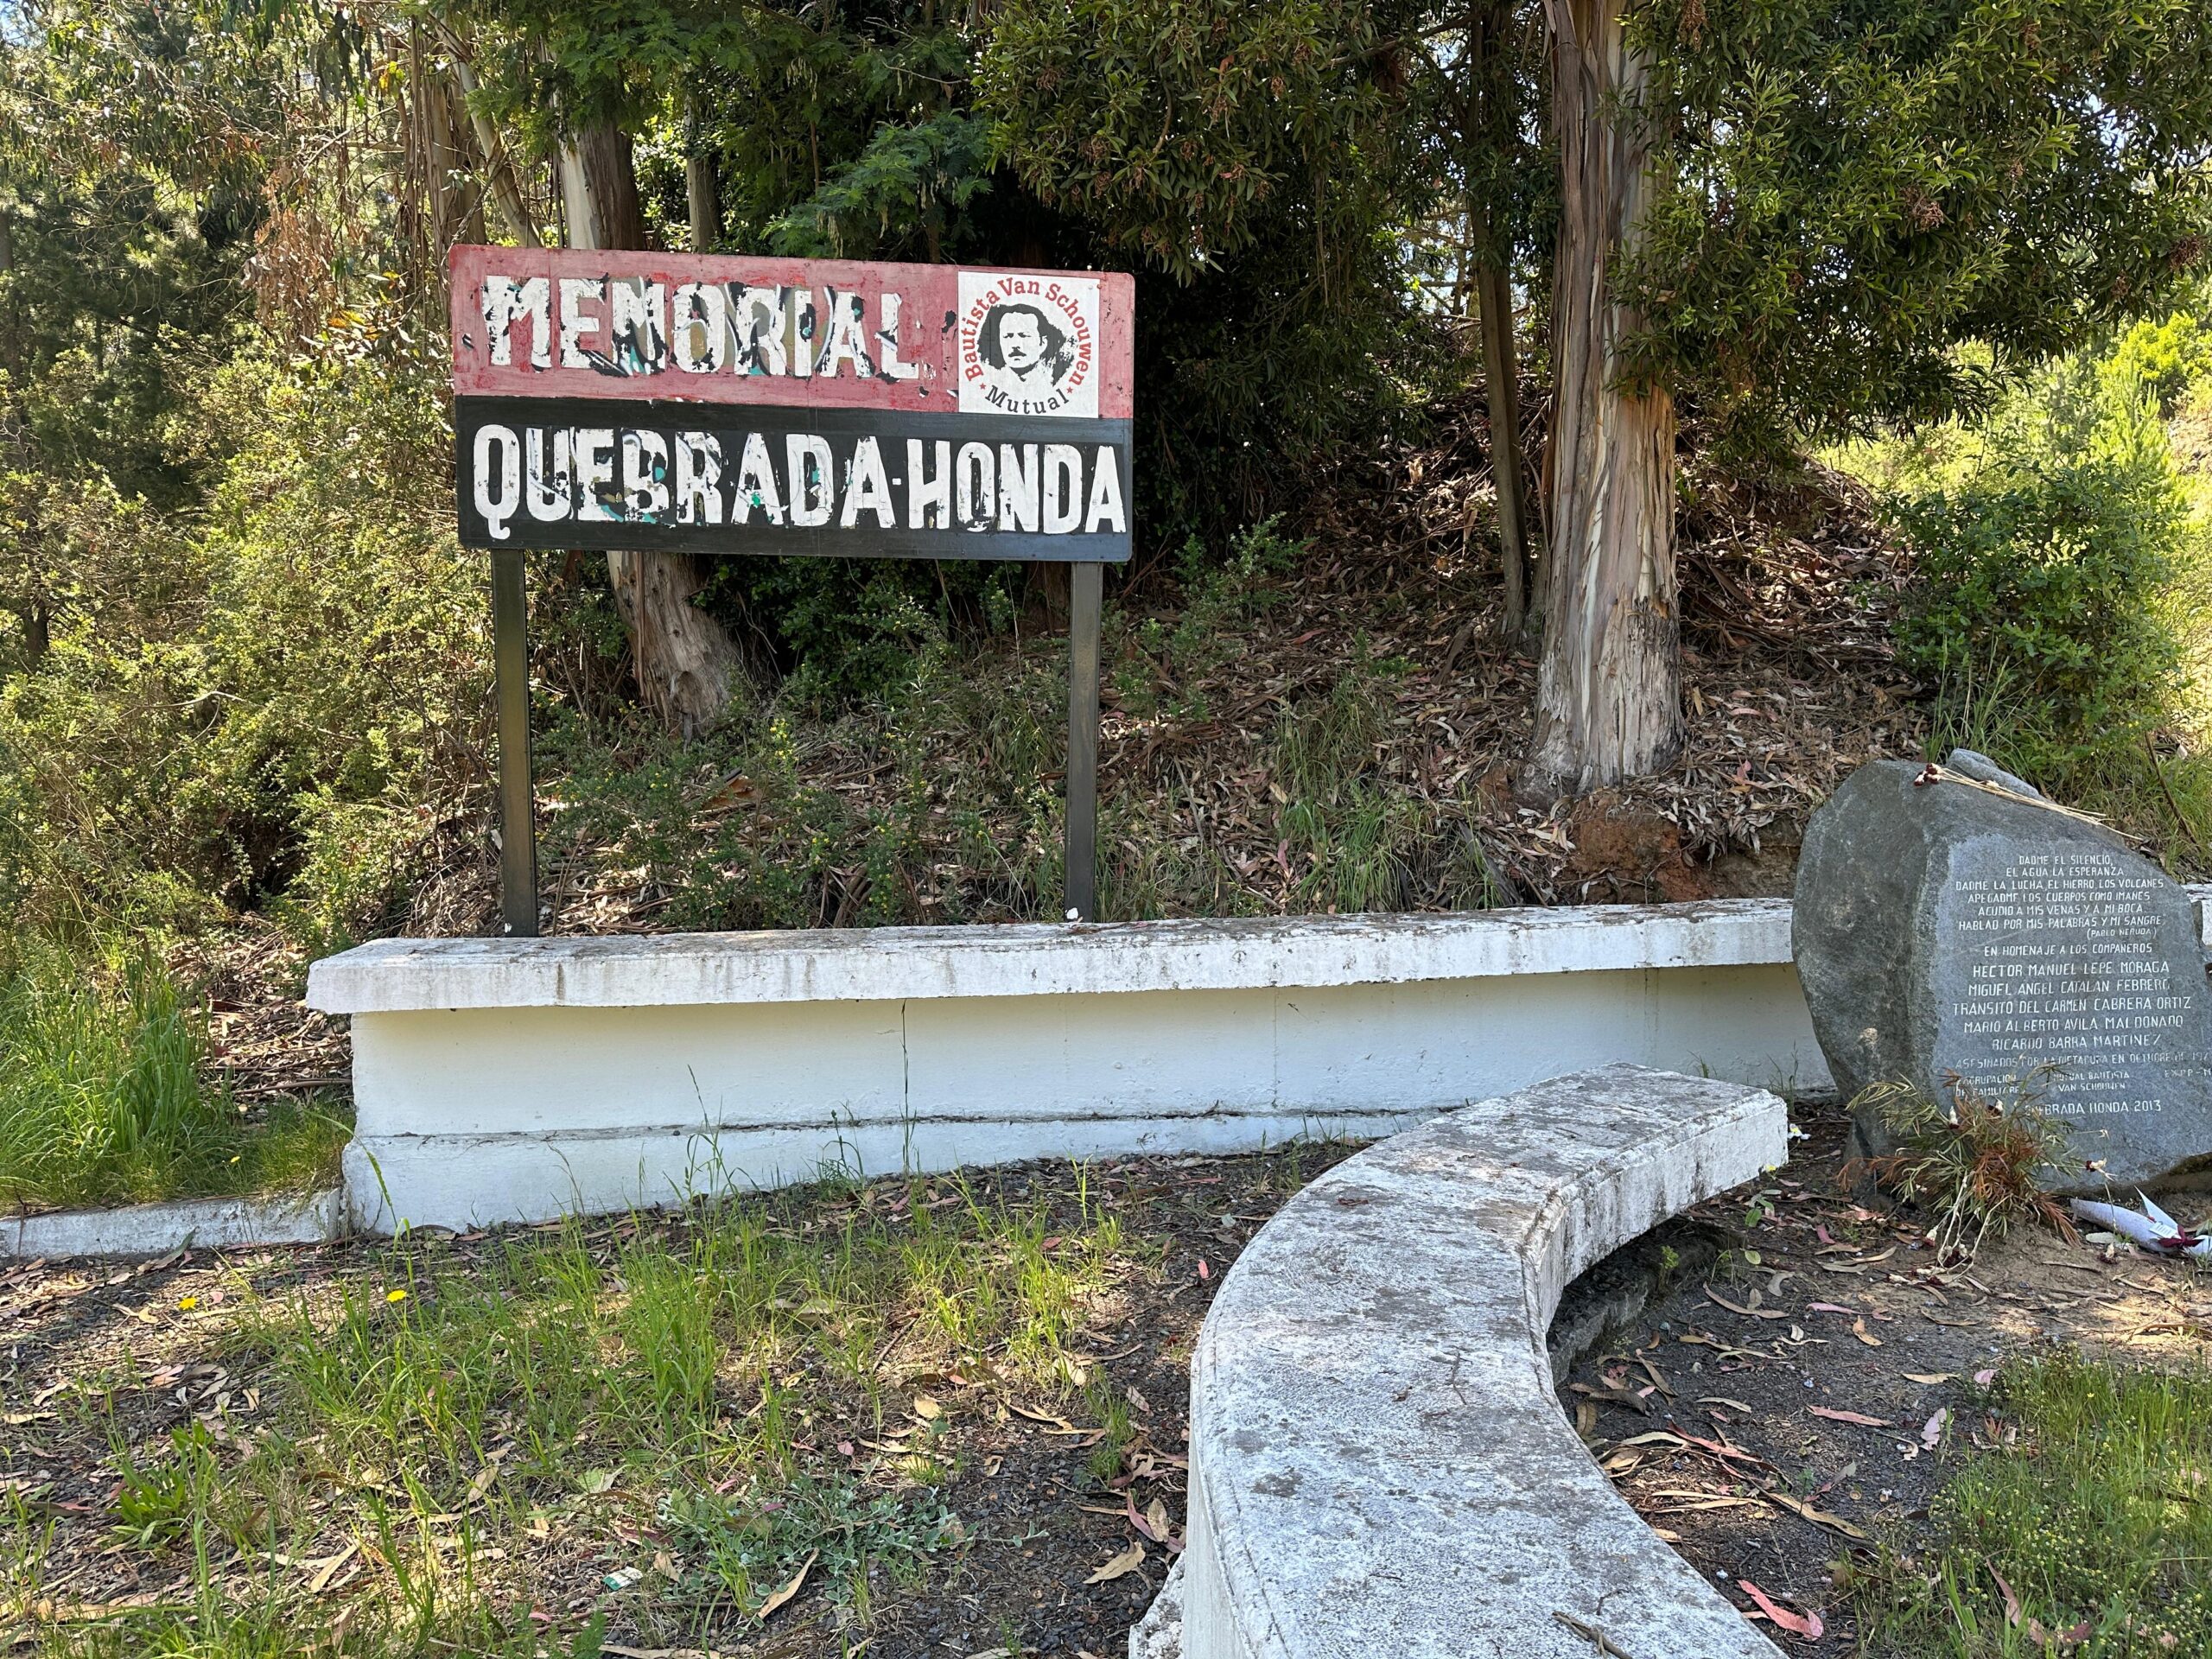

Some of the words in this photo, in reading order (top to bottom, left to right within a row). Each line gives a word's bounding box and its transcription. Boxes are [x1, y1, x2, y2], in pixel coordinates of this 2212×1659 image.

[482, 274, 918, 379] MEMORIAL
[961, 290, 1001, 381] Bautista
[997, 277, 1040, 296] Van
[1045, 283, 1092, 386] Schouwen
[985, 385, 1069, 415] Mutual
[2018, 855, 2049, 865] DADME
[2055, 855, 2066, 865] EL
[2005, 867, 2018, 877] EL
[2022, 867, 2049, 877] AGUA
[2052, 867, 2064, 876] LA
[1955, 880, 1989, 891] DADME
[1993, 880, 2006, 890] LA
[2048, 880, 2059, 889] EL
[2099, 879, 2115, 889] LOS
[2119, 879, 2164, 888] VOLCANES
[2023, 893, 2041, 902] LOS
[2046, 892, 2087, 902] CUERPOS
[2089, 892, 2113, 901] COMO
[2115, 891, 2151, 900] IMANES
[2016, 906, 2024, 916] A
[2026, 906, 2044, 915] MIS
[2046, 905, 2081, 915] VENAS
[2083, 904, 2090, 914] Y
[2093, 904, 2100, 914] A
[2104, 904, 2115, 914] MI
[2004, 918, 2022, 930] POR
[2026, 918, 2044, 929] MIS
[2049, 917, 2097, 928] PALABRAS
[2101, 917, 2108, 927] Y
[2110, 916, 2121, 926] MI
[1984, 945, 1998, 957] EN
[2002, 944, 2056, 956] HOMENAJE
[2059, 944, 2066, 954] A
[2070, 944, 2087, 954] LOS
[1973, 964, 2023, 978] HECTOR
[2028, 963, 2076, 976] MANUEL
[2084, 962, 2113, 974] LEPE
[2120, 961, 2170, 974] MORAGA
[1968, 982, 2012, 996] MIGUEL
[2018, 982, 2055, 995] ANGEL
[2061, 980, 2109, 994] CATALAN
[1953, 1001, 2013, 1016] TRANSITO
[2019, 1001, 2040, 1014] DEL
[2045, 999, 2087, 1013] CARMEN
[2094, 997, 2152, 1011] CABRERA
[2158, 996, 2191, 1009] ORTIZ
[1964, 1020, 2001, 1033] MARIO
[2064, 1017, 2098, 1031] AVILA
[2105, 1015, 2183, 1030] MALDONADO
[1992, 1038, 2043, 1051] RICARDO
[2049, 1036, 2088, 1049] BARRA
[2112, 1053, 2125, 1064] EN
[2058, 1084, 2076, 1092] VAN
[2089, 1102, 2129, 1114] HONDA
[2134, 1100, 2161, 1112] 2013
